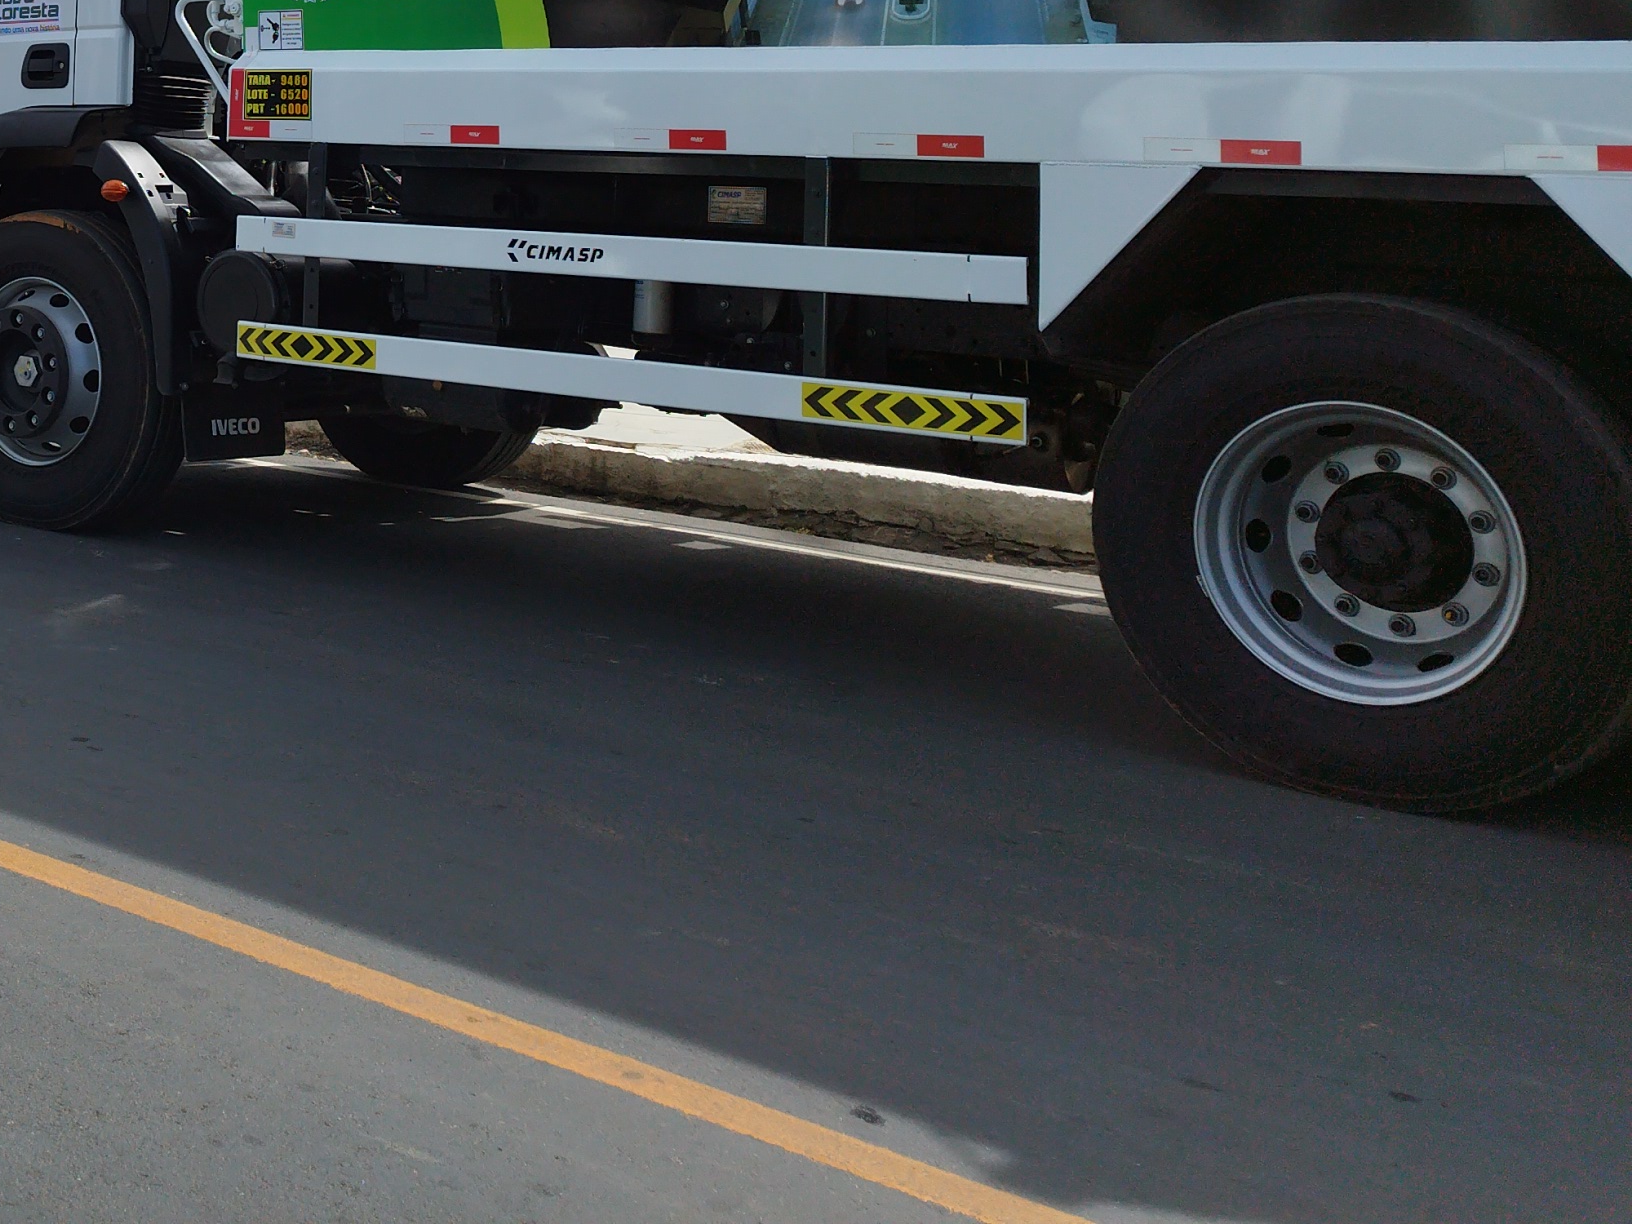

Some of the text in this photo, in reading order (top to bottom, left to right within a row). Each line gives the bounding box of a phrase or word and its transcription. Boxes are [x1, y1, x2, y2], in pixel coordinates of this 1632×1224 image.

[280, 88, 309, 100] 6520
[247, 103, 266, 114] PBT
[526, 244, 604, 263] CIMASP
[211, 417, 261, 436] IVECO
